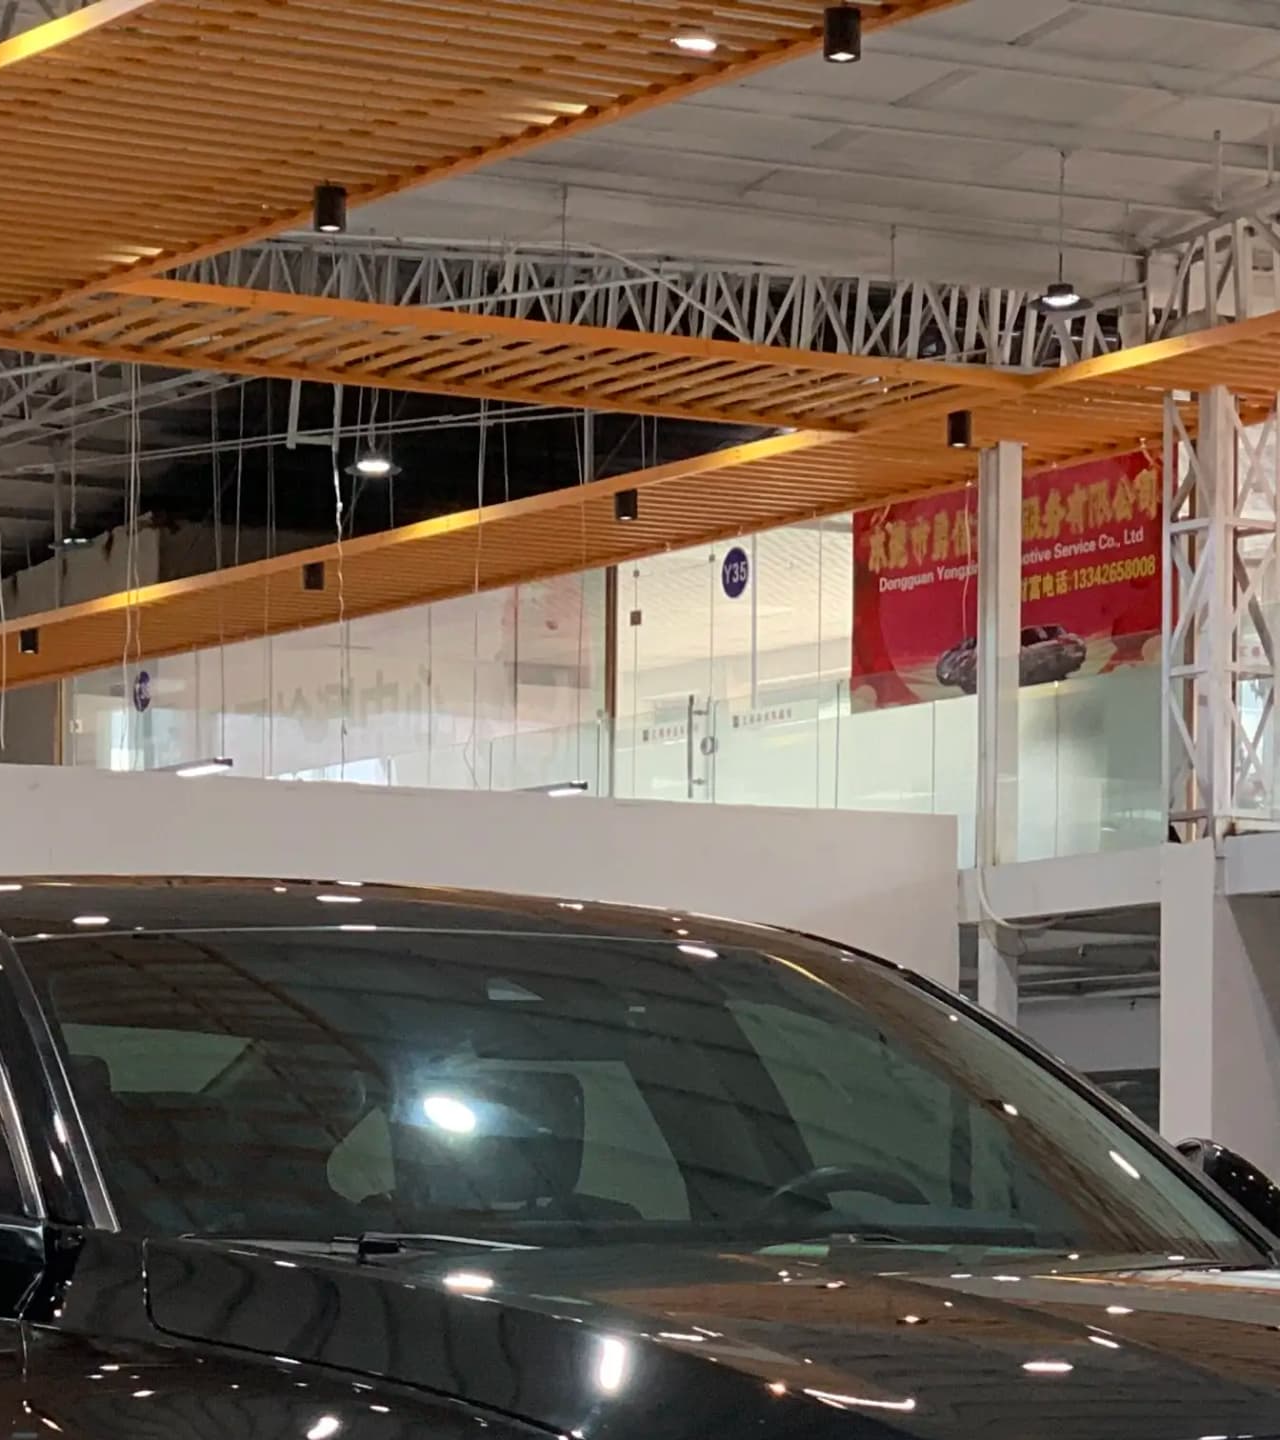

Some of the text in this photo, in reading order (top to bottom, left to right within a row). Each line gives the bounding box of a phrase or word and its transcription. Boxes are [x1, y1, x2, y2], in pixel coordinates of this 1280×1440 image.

[722, 559, 747, 585] Y35
[879, 571, 934, 592] Dongguan
[1053, 540, 1097, 560] Service
[1124, 526, 1144, 545] Ltd
